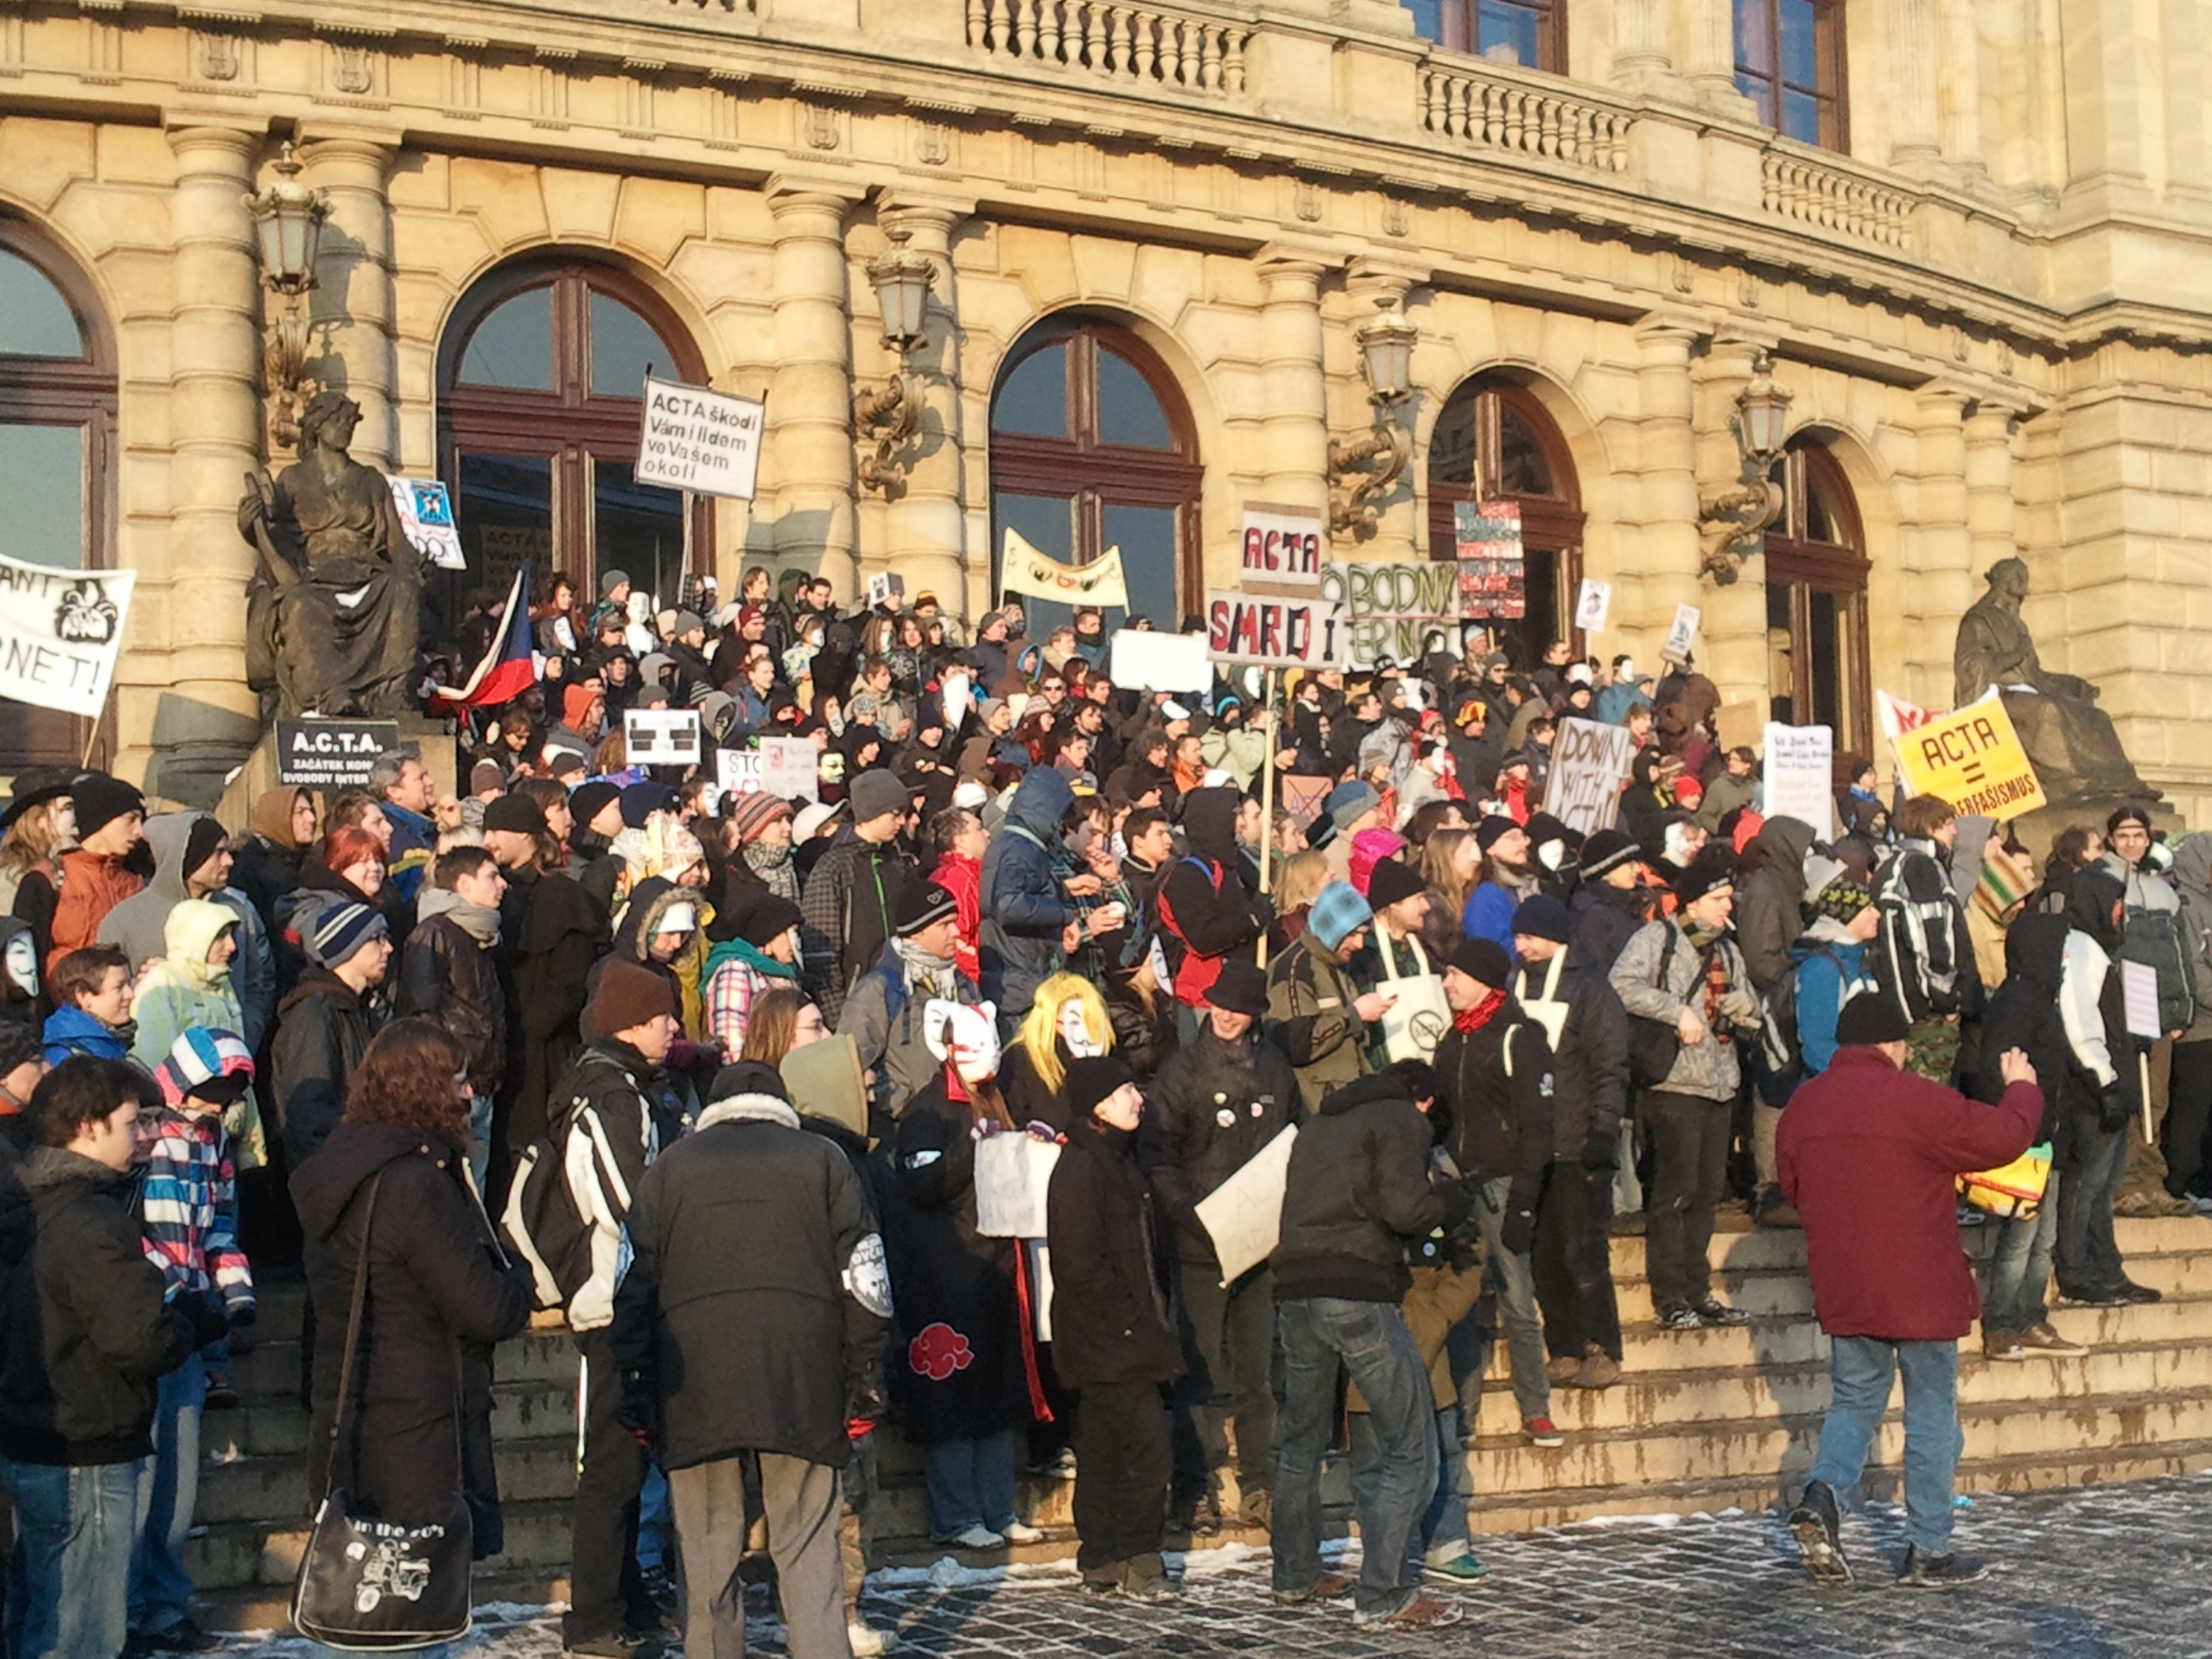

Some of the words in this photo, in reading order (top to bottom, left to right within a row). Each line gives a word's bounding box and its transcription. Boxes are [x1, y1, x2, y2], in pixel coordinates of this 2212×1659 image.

[652, 393, 706, 419] ACTA
[1243, 526, 1320, 575] ACTA
[0, 563, 60, 598] ANT
[1210, 600, 1344, 662] SMRDÍ
[0, 637, 100, 696] NET!
[292, 731, 384, 753] A.C.T.A.
[1921, 716, 1999, 772] ACTA
[334, 773, 370, 785] INTER
[1948, 773, 2036, 817] ERFAŠISMUS
[376, 1522, 405, 1537] the
